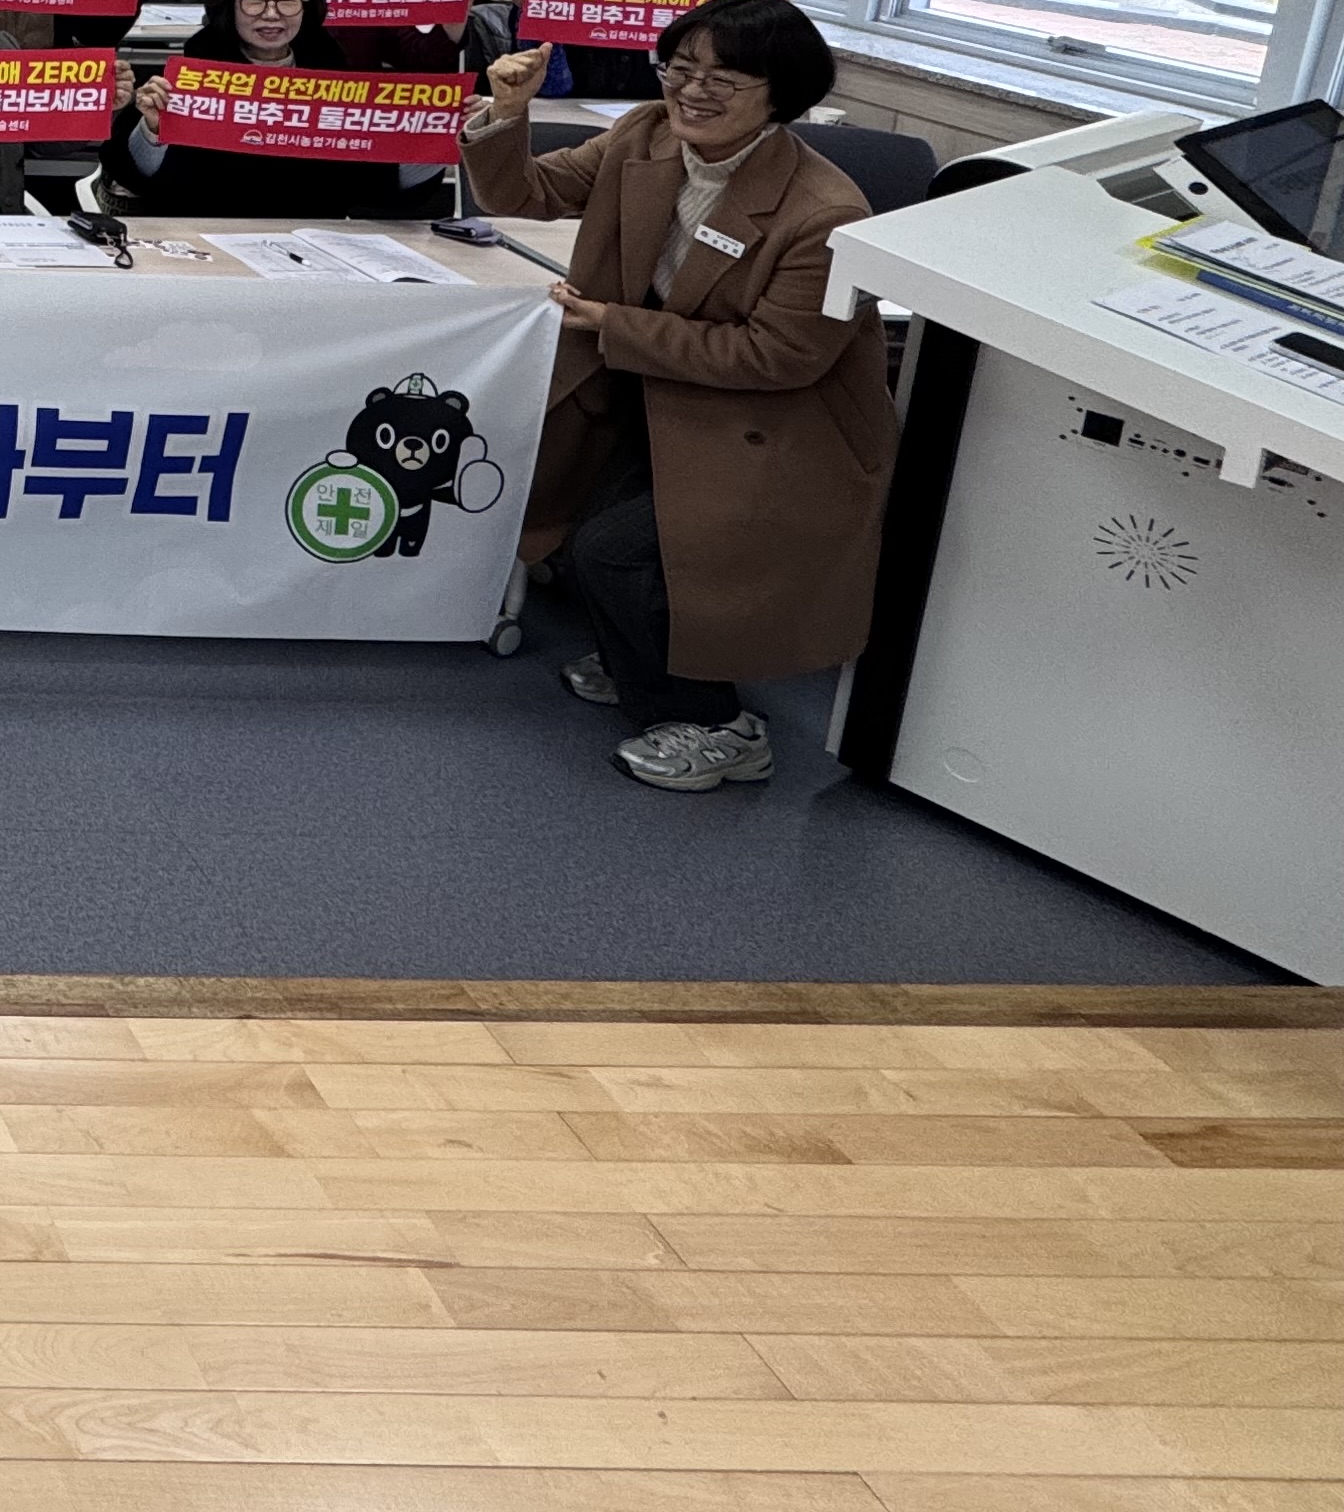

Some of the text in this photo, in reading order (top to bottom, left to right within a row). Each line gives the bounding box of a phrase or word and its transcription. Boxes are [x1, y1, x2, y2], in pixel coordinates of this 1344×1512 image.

[527, 0, 574, 21] 잠깐!
[582, 4, 645, 26] 멈추고
[27, 61, 106, 84] ZERO!
[177, 66, 461, 107] 농작업 안전재해 ZERO!
[167, 94, 460, 134] 잠깐! 멈추고 둘러보세요!
